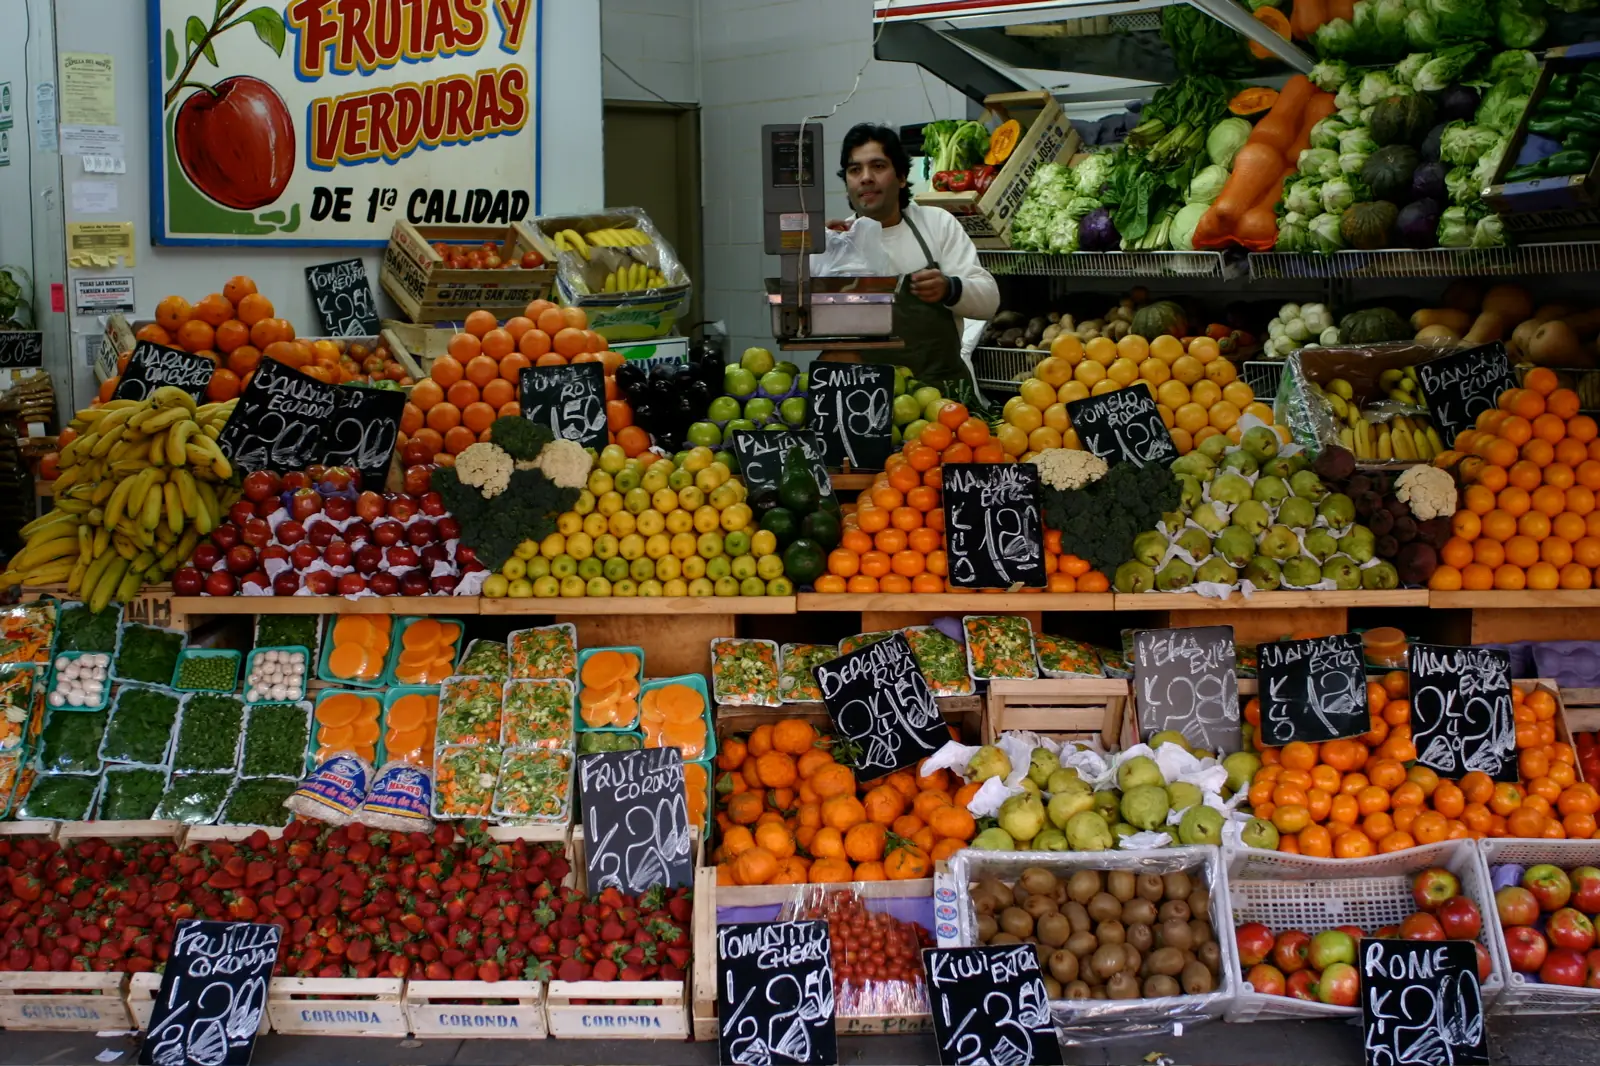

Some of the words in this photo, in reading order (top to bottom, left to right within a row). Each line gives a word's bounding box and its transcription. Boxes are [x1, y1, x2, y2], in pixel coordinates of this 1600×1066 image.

[289, 0, 489, 76] FRUTAS
[494, 0, 531, 51] Y
[311, 65, 528, 167] VERDURAS
[310, 186, 354, 223] DE
[366, 187, 398, 223] 1ra
[406, 188, 530, 224] CALIDAD
[308, 260, 358, 291] TOMATE
[810, 365, 881, 390] SMITH
[832, 387, 890, 468] 180
[1365, 941, 1456, 980] ROME
[301, 1009, 381, 1025] CORONDA
[439, 1013, 519, 1028] CORONDA
[582, 1015, 661, 1029] CORONDA
